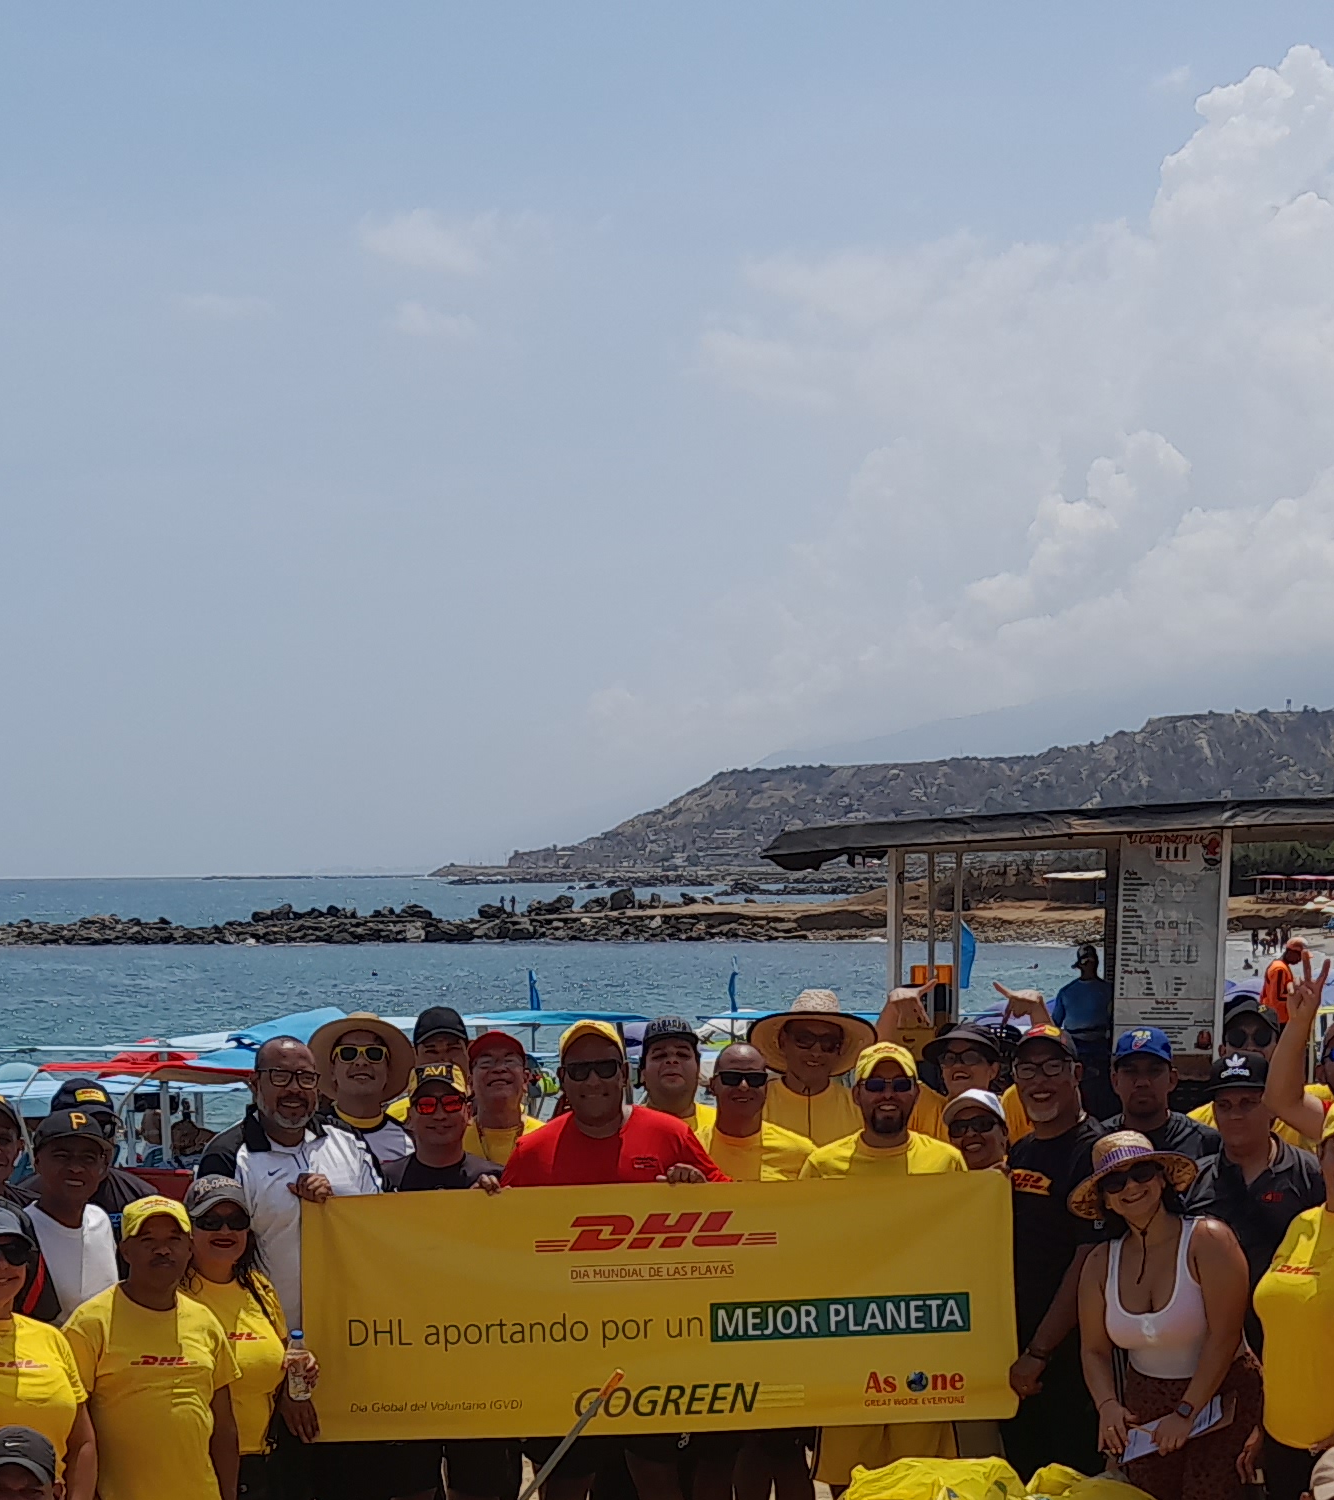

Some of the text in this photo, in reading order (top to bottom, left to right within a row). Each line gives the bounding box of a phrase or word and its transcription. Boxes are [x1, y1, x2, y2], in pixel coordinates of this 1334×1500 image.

[1220, 1067, 1251, 1079] adidas
[69, 1112, 88, 1130] P
[568, 1211, 745, 1252] DHL
[570, 1263, 735, 1280] DIA MUNDIAL DE LAS PLAYAS
[1276, 1264, 1316, 1276] DHL
[348, 1299, 965, 1352] DHL aportando por un MEJOR PLANETA
[140, 1355, 191, 1367] DHL
[865, 1371, 898, 1394] As
[371, 1401, 407, 1413] Global
[410, 1400, 427, 1412] del
[430, 1400, 487, 1412] Voluntario
[489, 1399, 523, 1411] (GVD)
[574, 1381, 761, 1419] GOGREEN
[864, 1395, 965, 1407] GREAT WORK EVERYONE
